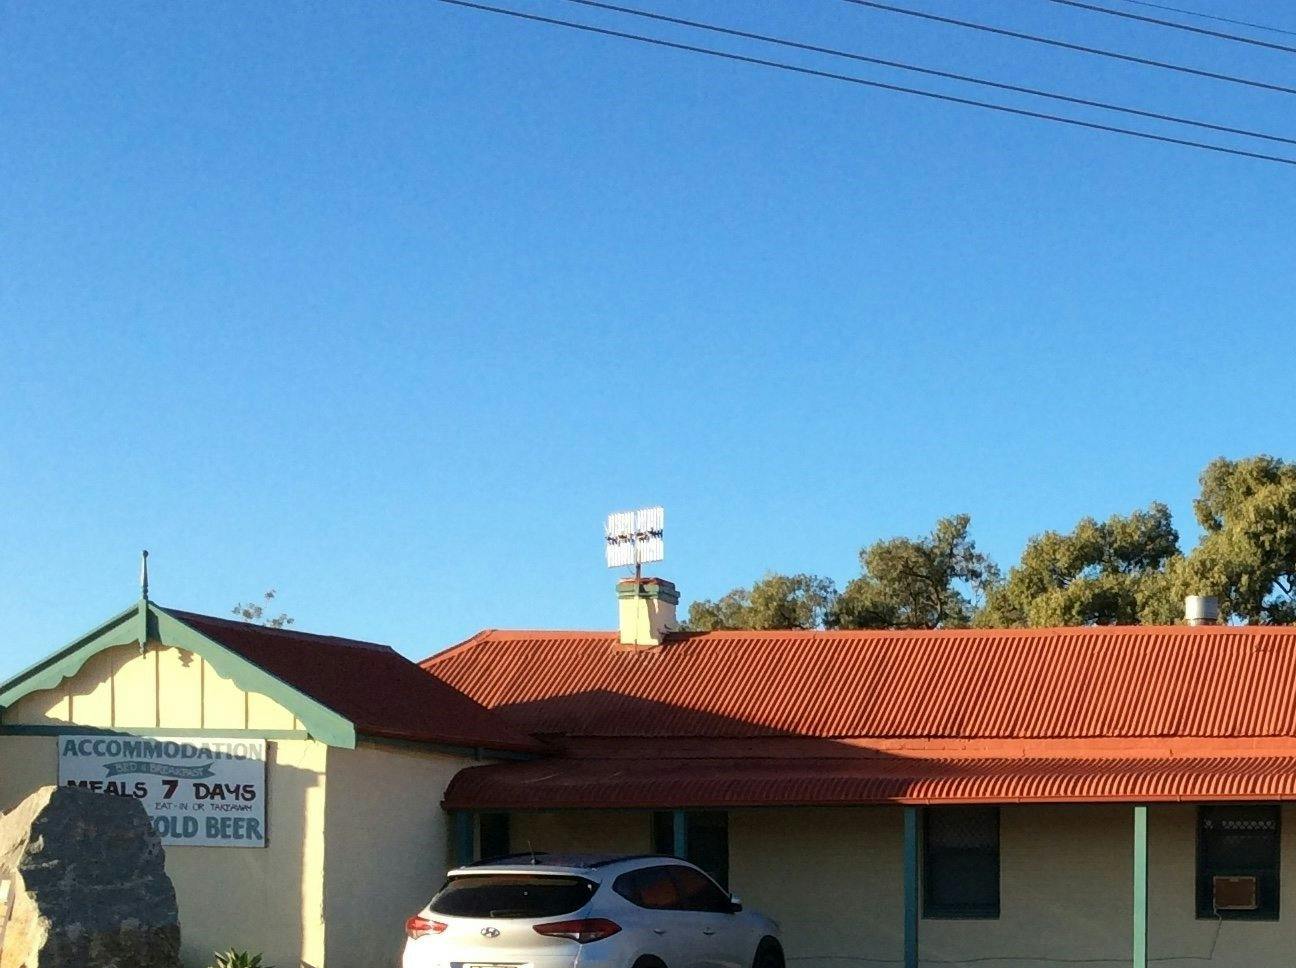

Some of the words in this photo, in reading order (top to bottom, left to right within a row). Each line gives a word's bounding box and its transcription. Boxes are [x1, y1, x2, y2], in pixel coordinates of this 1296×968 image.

[62, 739, 263, 761] ACCOMMODATION
[161, 780, 179, 799] 7
[193, 783, 256, 801] DAYS
[193, 803, 205, 811] OR
[148, 816, 198, 837] OLD
[206, 817, 263, 840] BEER
